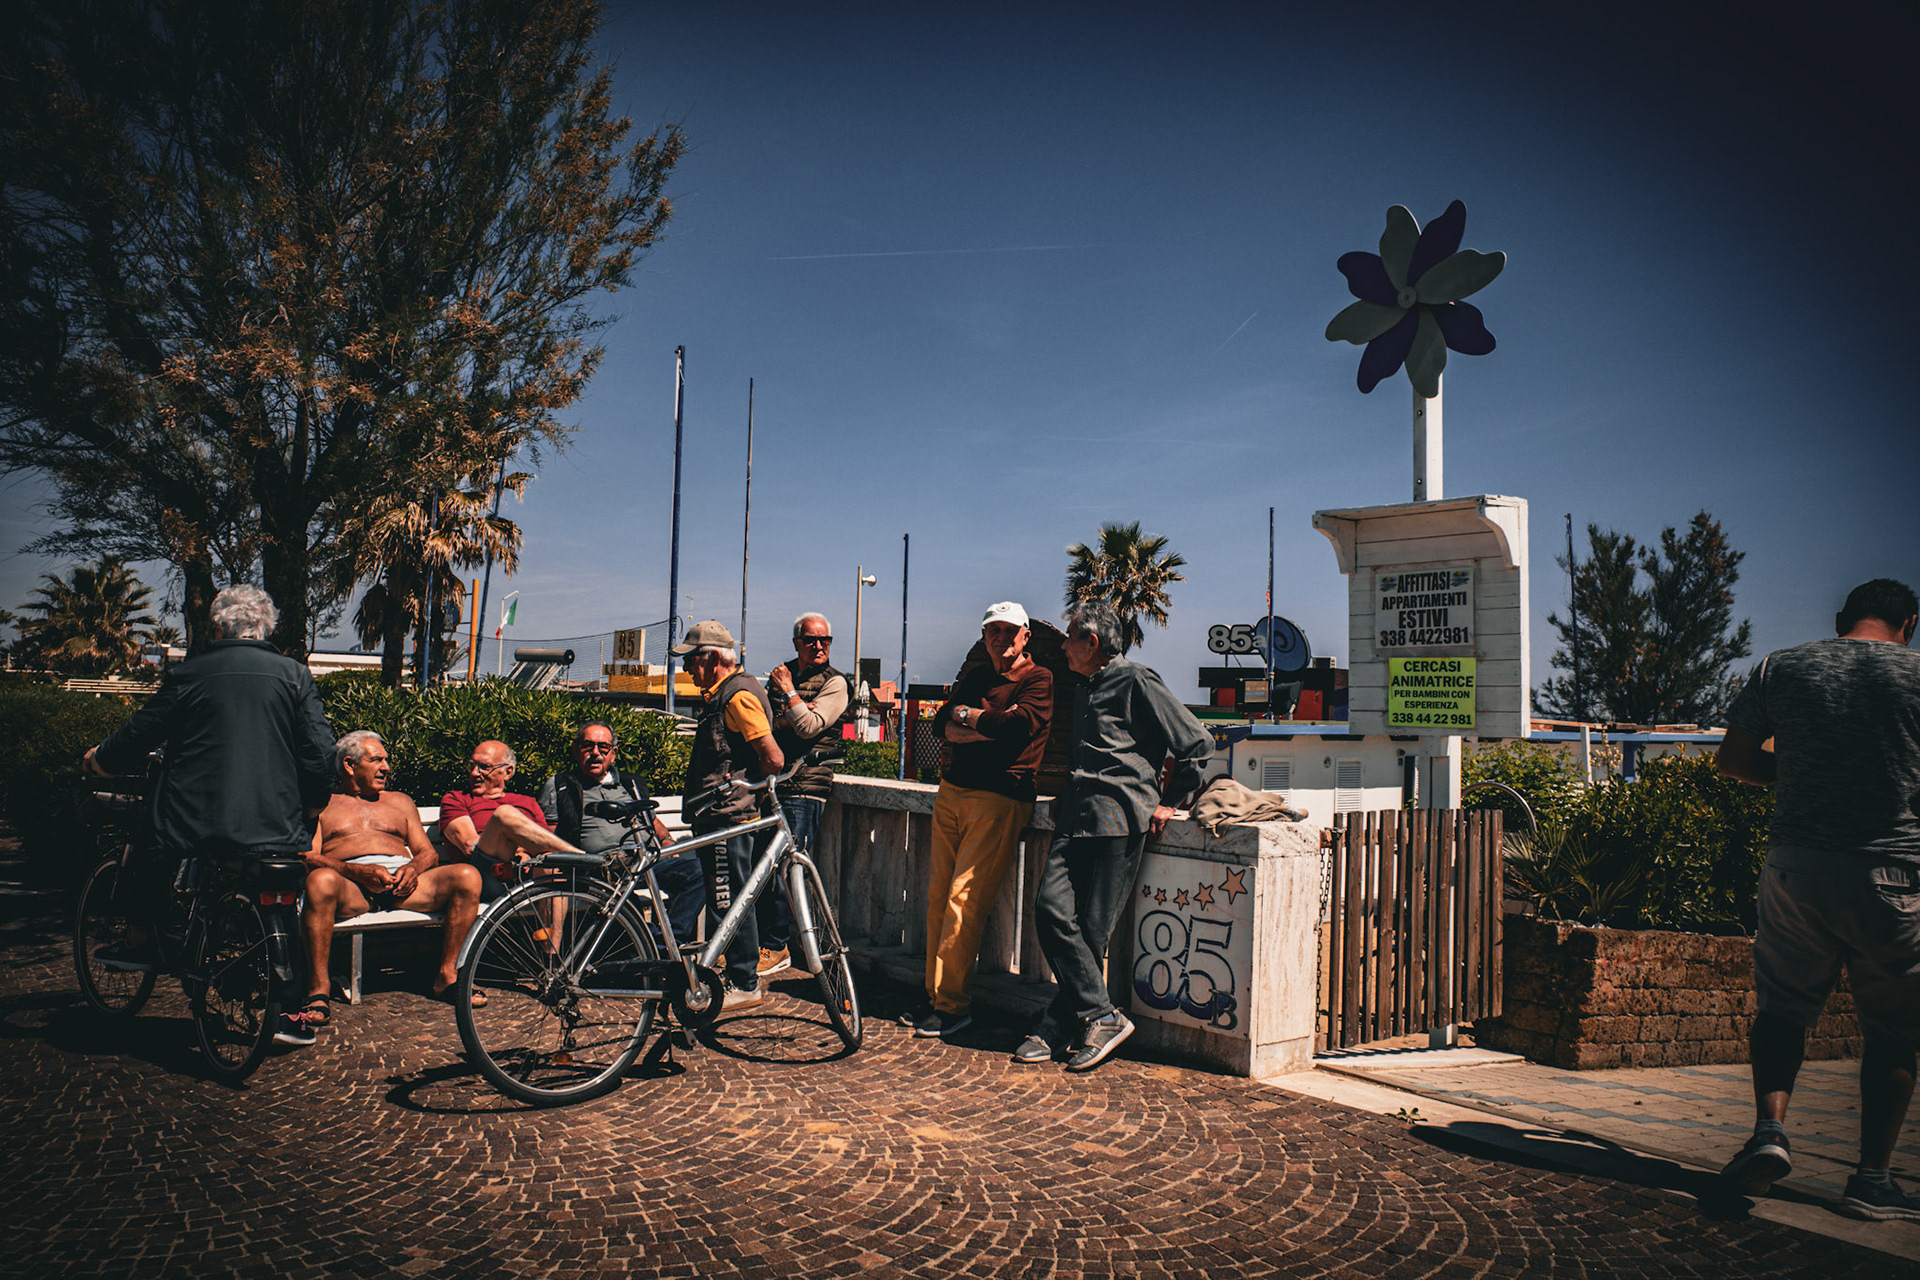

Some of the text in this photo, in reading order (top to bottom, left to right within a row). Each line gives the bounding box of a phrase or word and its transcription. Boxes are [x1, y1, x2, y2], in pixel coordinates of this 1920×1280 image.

[1397, 571, 1451, 593] AFFITTASI
[1381, 591, 1467, 611] APPARTAMENTI
[1398, 608, 1448, 629] ESTIVI
[1380, 626, 1469, 647] 338 4422981
[1403, 660, 1461, 673] CERCASI
[1391, 675, 1474, 688] ANIMATRICE
[1394, 689, 1470, 699] PER BAMBINI CON
[1404, 700, 1459, 710] ESPERIENZA
[1392, 712, 1472, 725] 338 44 22 981
